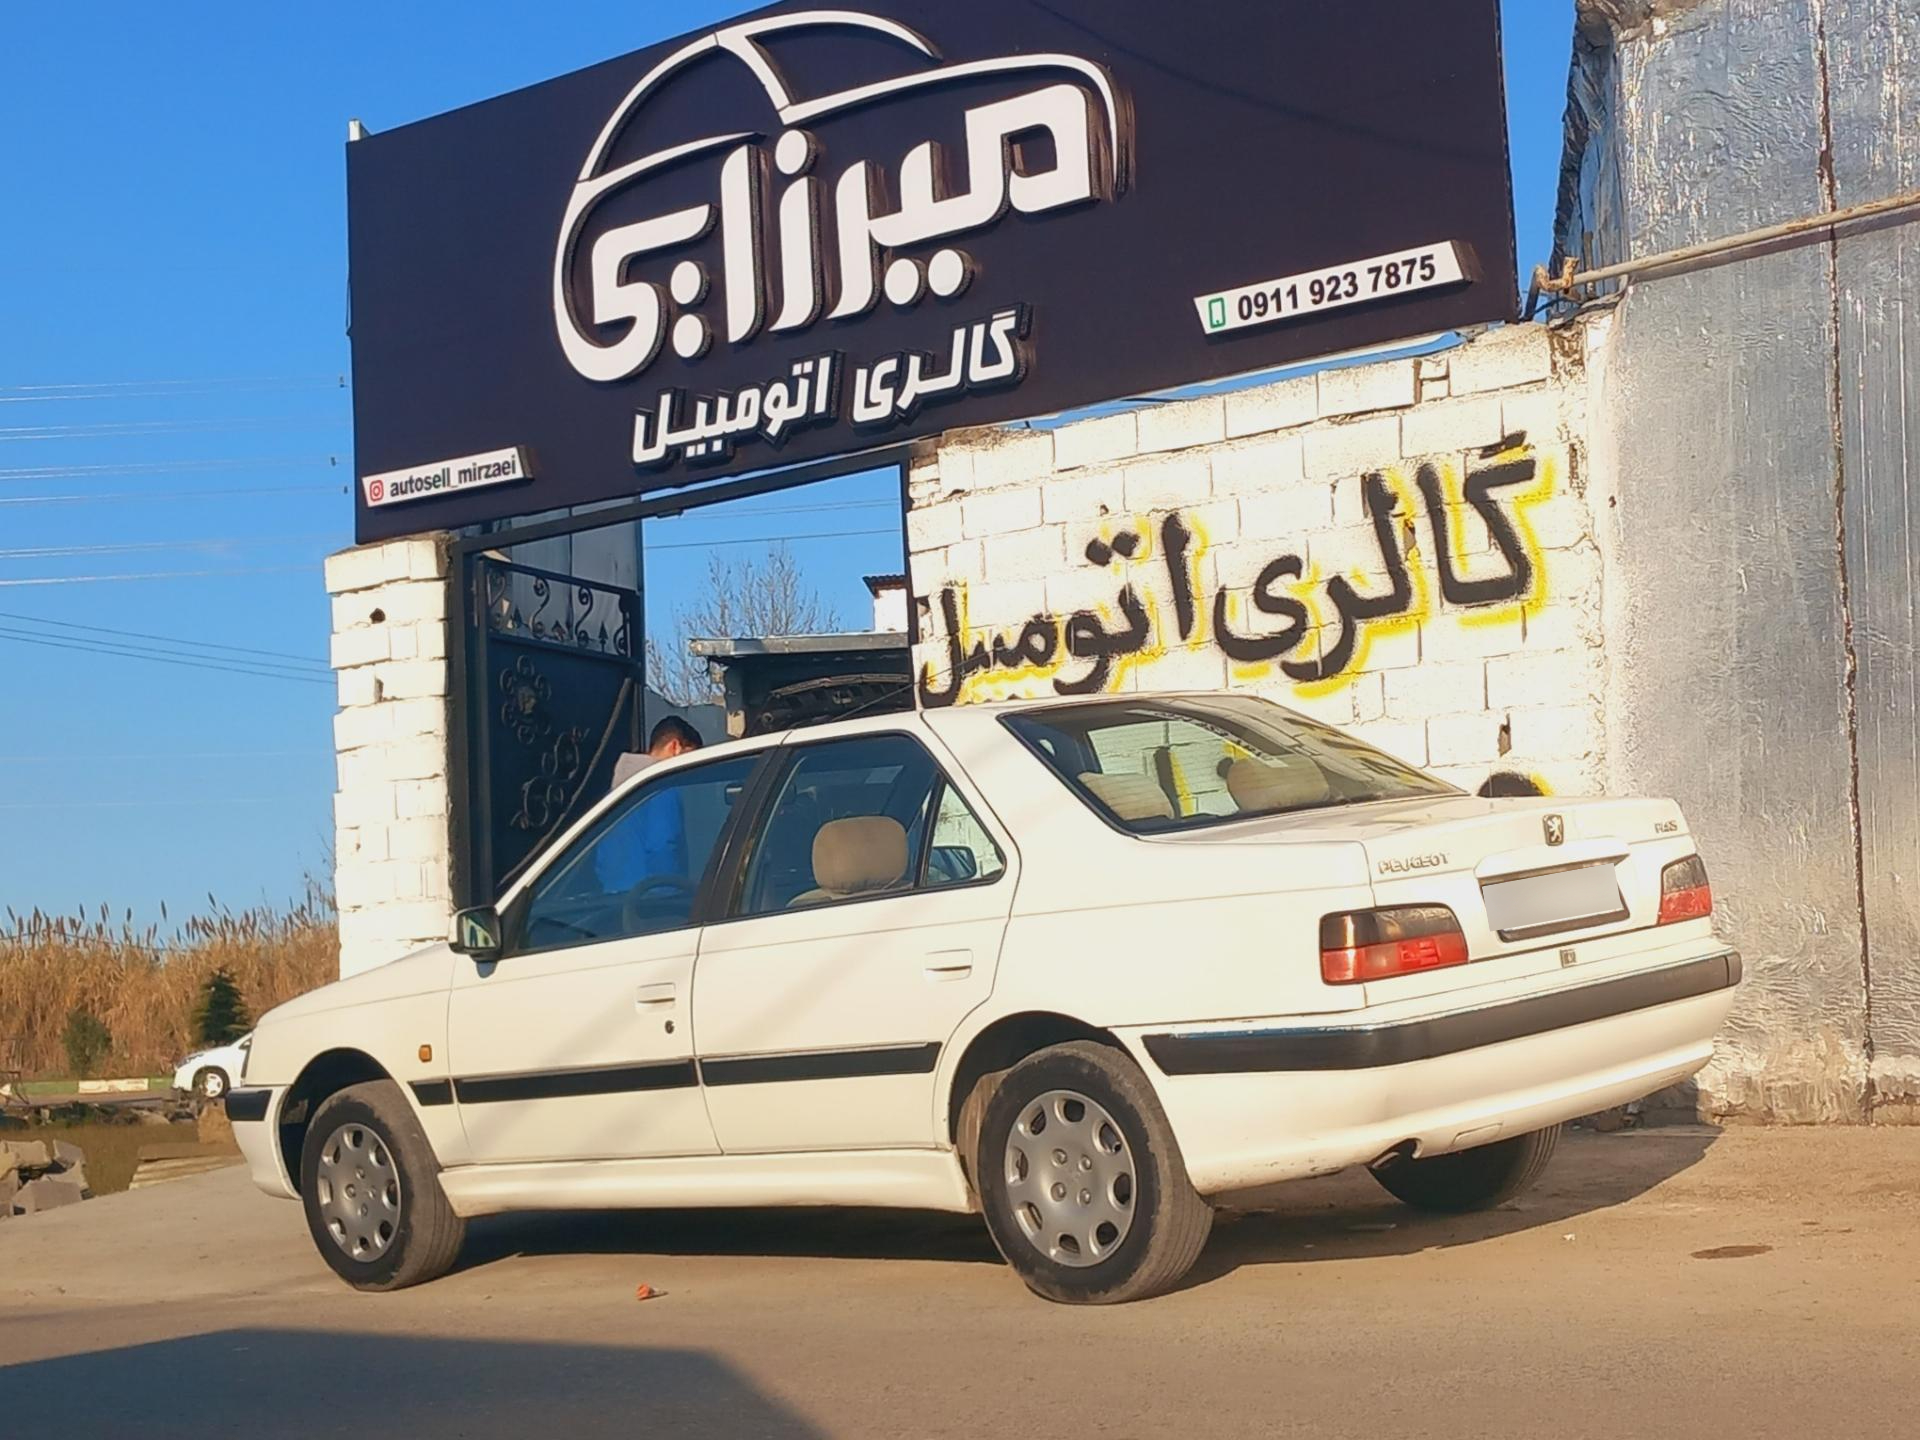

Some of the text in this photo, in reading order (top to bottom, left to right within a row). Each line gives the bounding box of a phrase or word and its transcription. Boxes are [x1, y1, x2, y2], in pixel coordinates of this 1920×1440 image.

[1238, 254, 1436, 321] 0911 923 7875
[632, 310, 1017, 463] گالری اتومبیل
[390, 454, 517, 498] autosell_mirzaei
[1214, 430, 1537, 683] گالری
[1378, 853, 1450, 874] PEUGEOT
